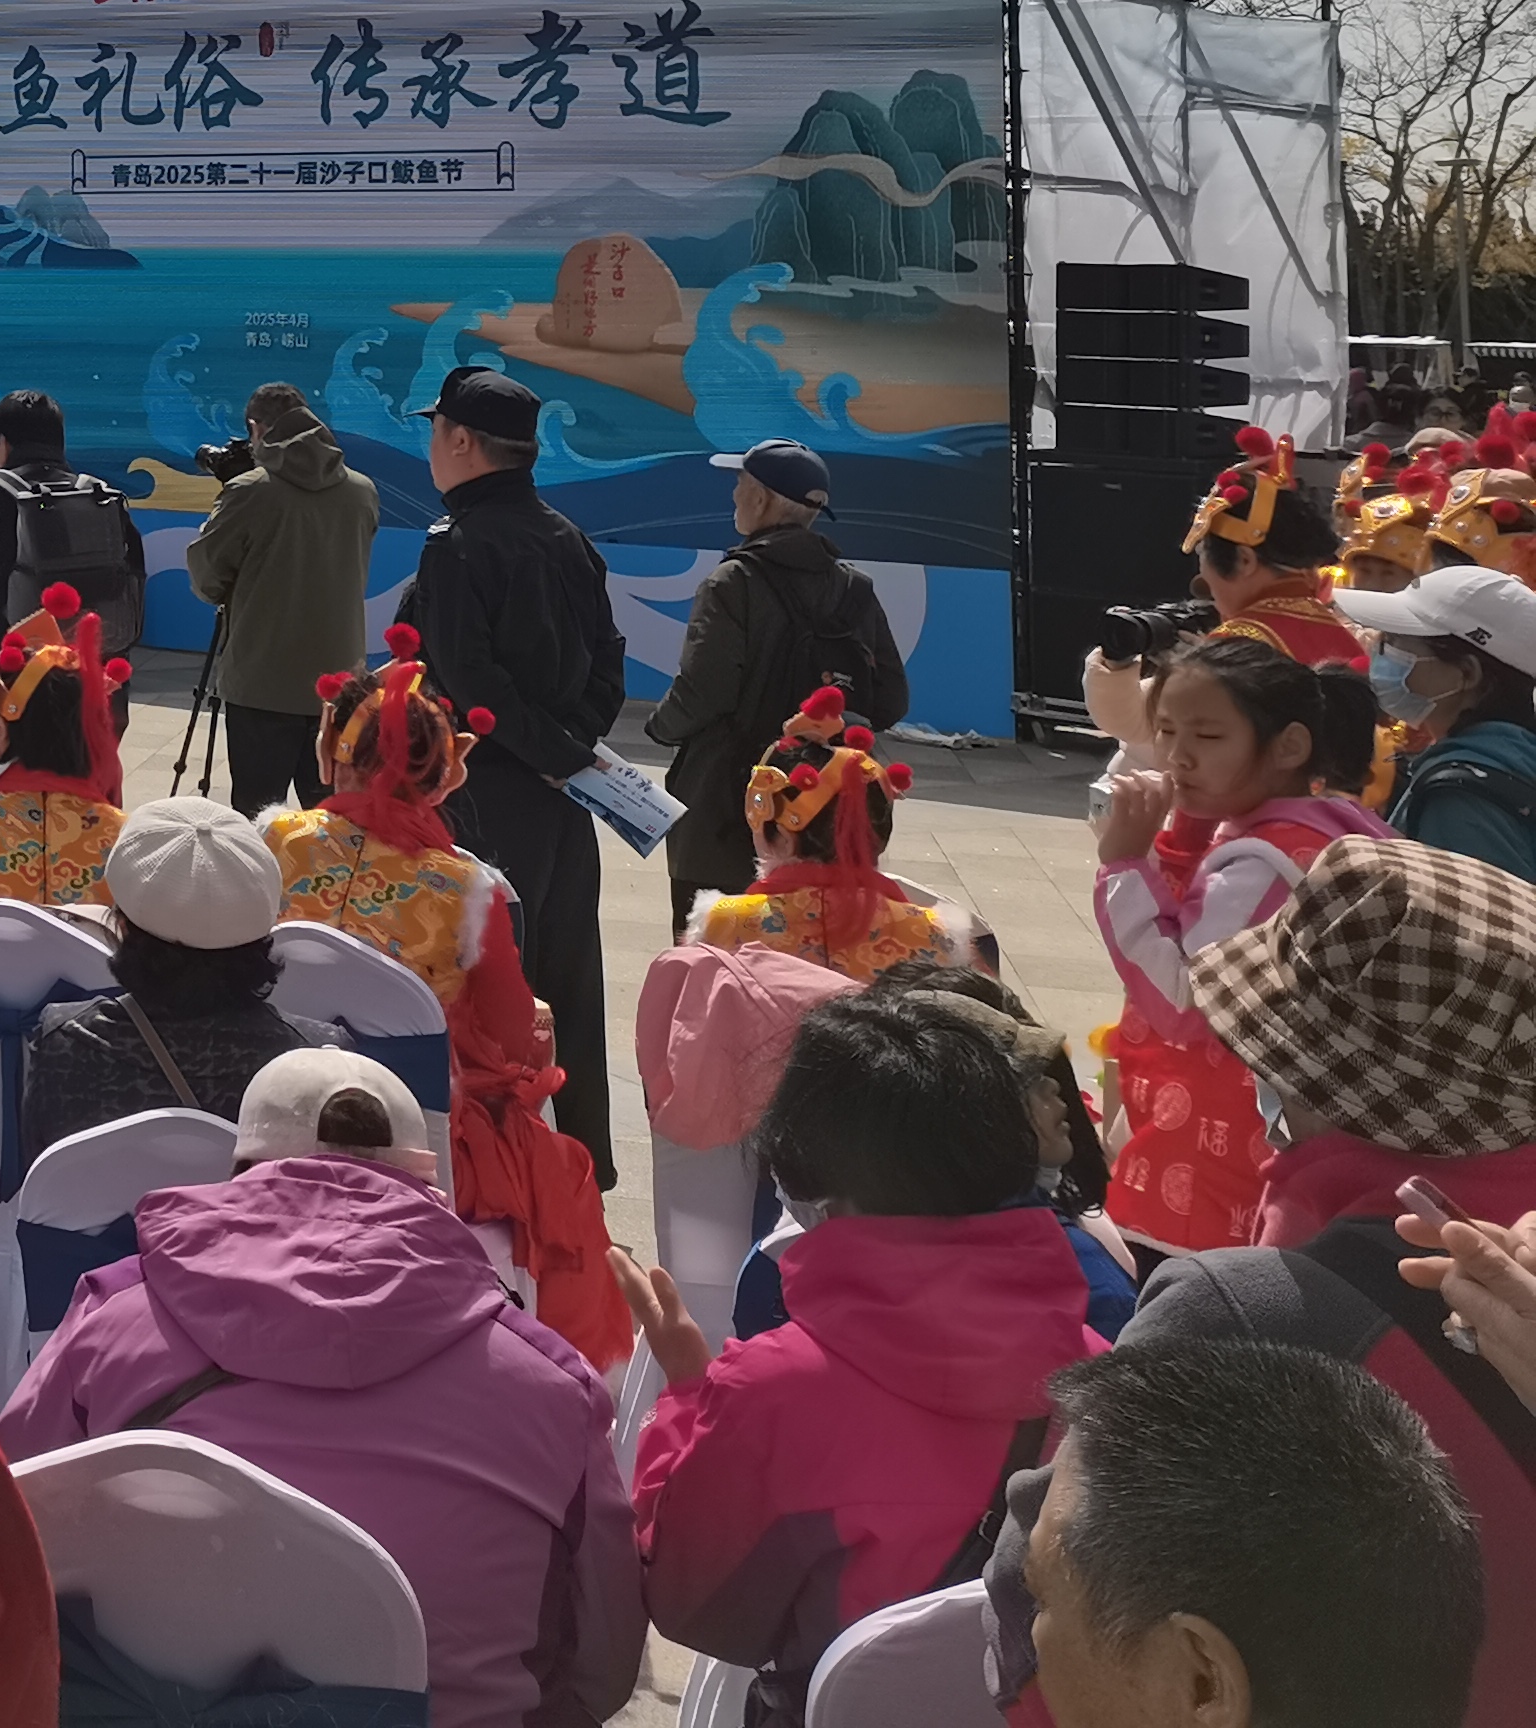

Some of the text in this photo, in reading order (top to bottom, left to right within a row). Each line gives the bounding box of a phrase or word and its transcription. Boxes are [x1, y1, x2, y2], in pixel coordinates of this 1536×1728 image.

[111, 158, 466, 189] 青岛2025第二十一届沙子口鲅鱼节
[245, 312, 309, 328] 2025年4月
[246, 332, 308, 348] 青岛·崂山
